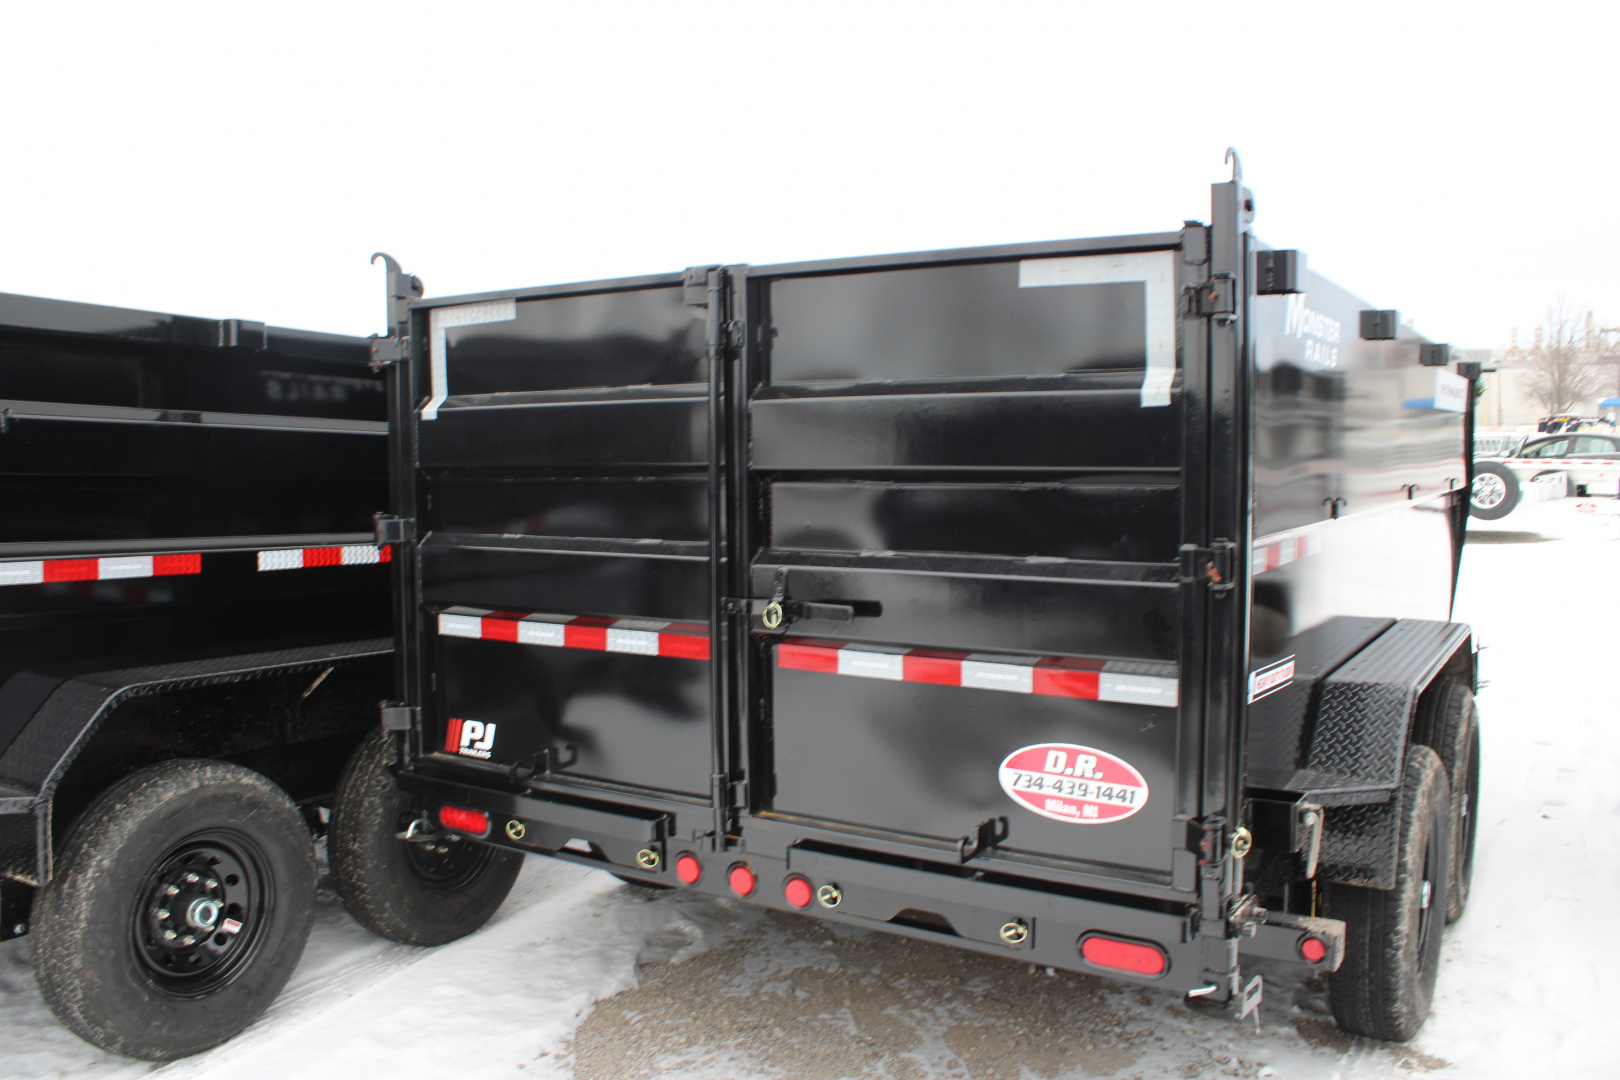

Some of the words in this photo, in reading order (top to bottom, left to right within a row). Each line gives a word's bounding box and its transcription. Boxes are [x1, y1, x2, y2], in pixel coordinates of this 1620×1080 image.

[1284, 293, 1341, 344] MONSTER
[1304, 338, 1338, 368] RAILS
[460, 720, 497, 751] PJ
[459, 747, 492, 760] TRAILERS
[1043, 749, 1104, 780] D.R.
[1012, 772, 1136, 804] 734-439-1441
[1044, 797, 1081, 818] Milan,
[1082, 804, 1099, 820] MI
